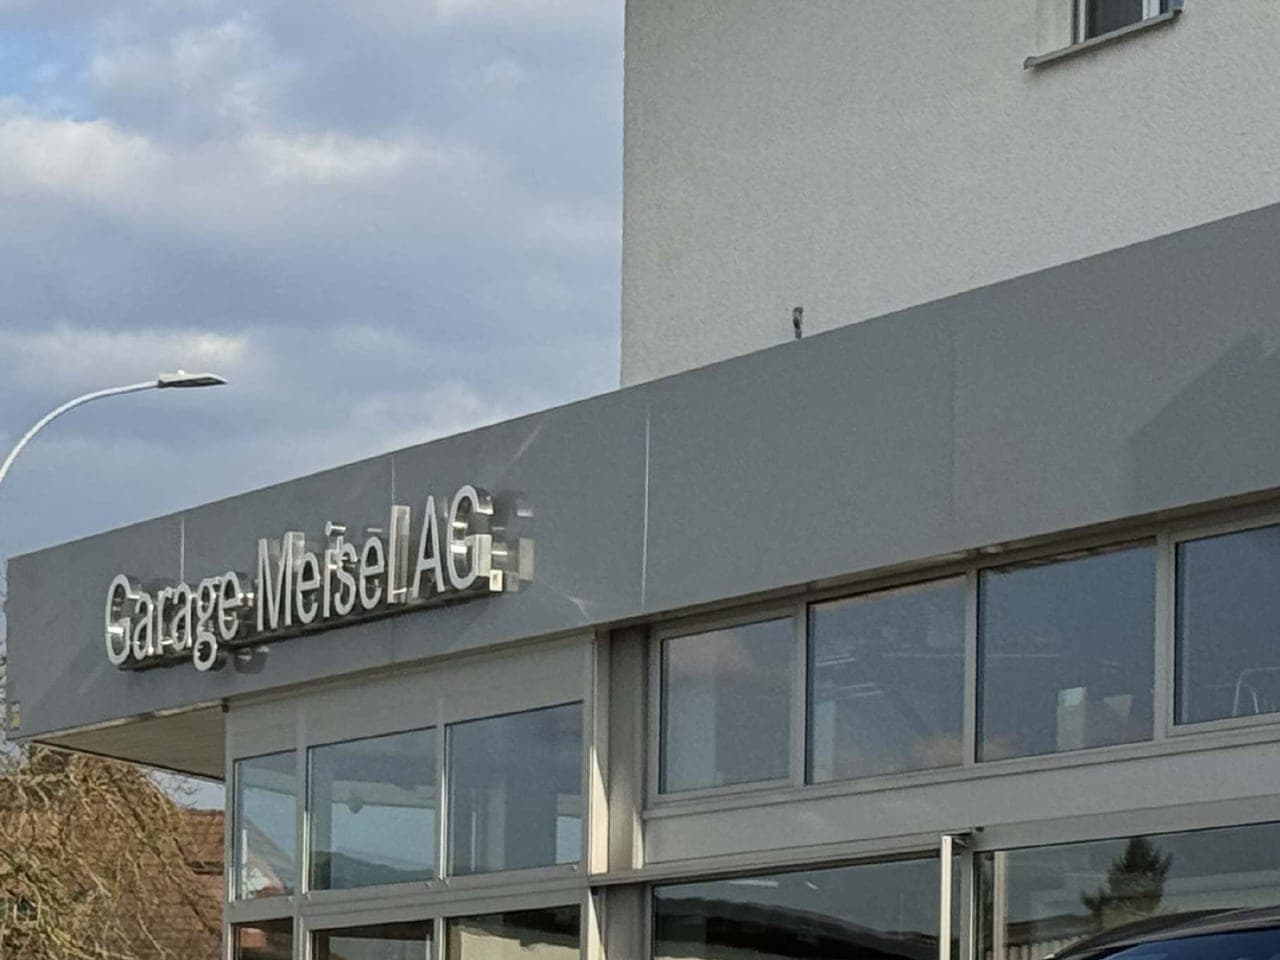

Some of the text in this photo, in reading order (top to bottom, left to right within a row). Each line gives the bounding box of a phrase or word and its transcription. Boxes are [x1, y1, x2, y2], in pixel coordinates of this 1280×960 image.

[104, 484, 499, 672] Garage Meisel AG
